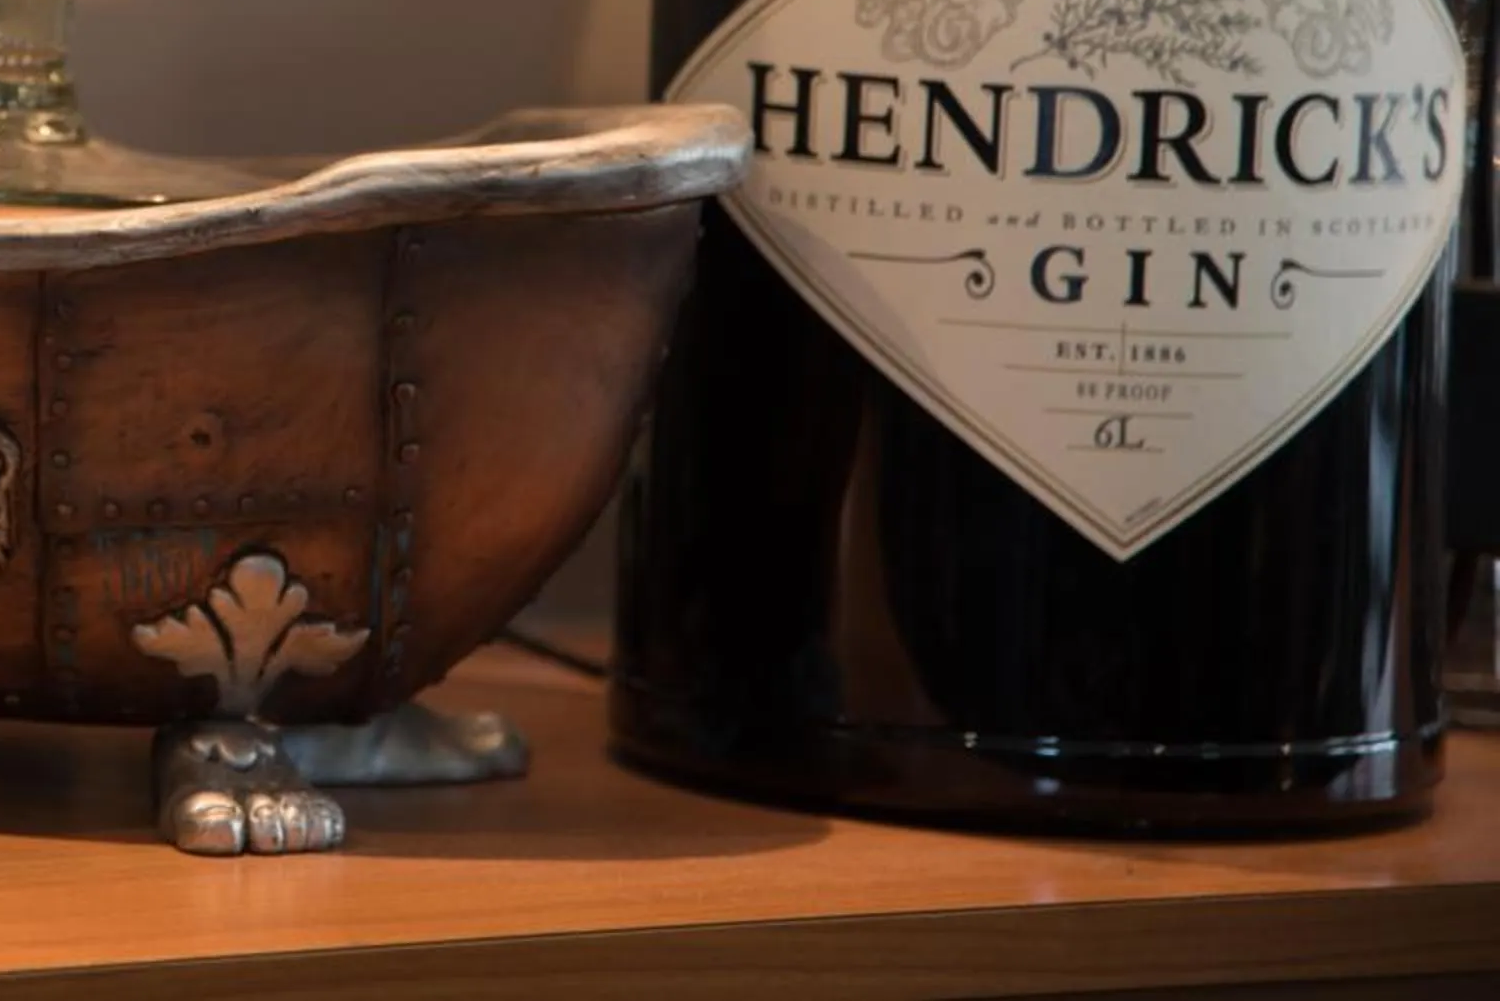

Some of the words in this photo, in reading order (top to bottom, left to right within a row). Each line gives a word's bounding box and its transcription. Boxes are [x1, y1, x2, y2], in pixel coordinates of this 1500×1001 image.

[746, 62, 1450, 187] HENDRICK'S
[769, 187, 964, 224] DISTILLED
[986, 212, 1042, 229] and
[1062, 213, 1236, 236] BOTTLED
[1258, 218, 1293, 237] IN
[1030, 245, 1246, 311] GIN
[1056, 341, 1116, 363] EST.
[1130, 344, 1187, 365] 1886
[1105, 382, 1173, 402] PROOF
[1093, 416, 1148, 449] 6L
